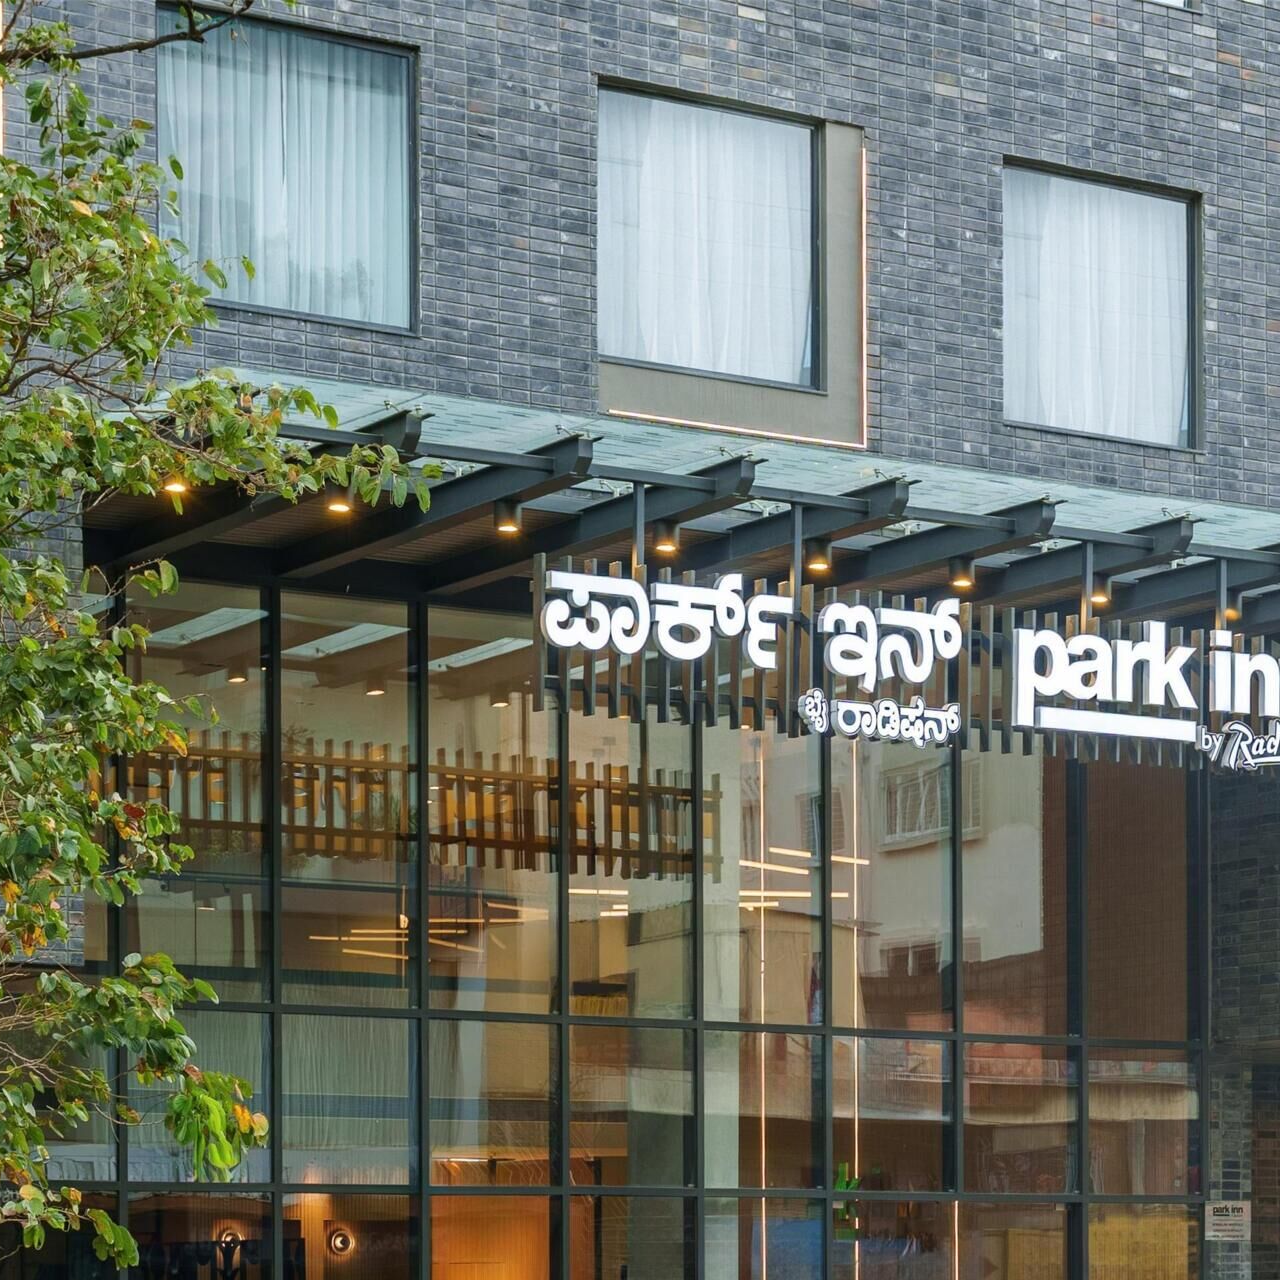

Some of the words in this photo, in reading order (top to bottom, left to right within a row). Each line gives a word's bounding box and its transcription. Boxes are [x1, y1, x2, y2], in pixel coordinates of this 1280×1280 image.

[540, 570, 793, 669] ಪಾರ್ಕ್
[818, 598, 962, 693] ಇನ್
[1012, 620, 1198, 727] park
[1197, 725, 1225, 762] by
[1213, 1205, 1230, 1216] park
[1231, 1205, 1243, 1213] inn
